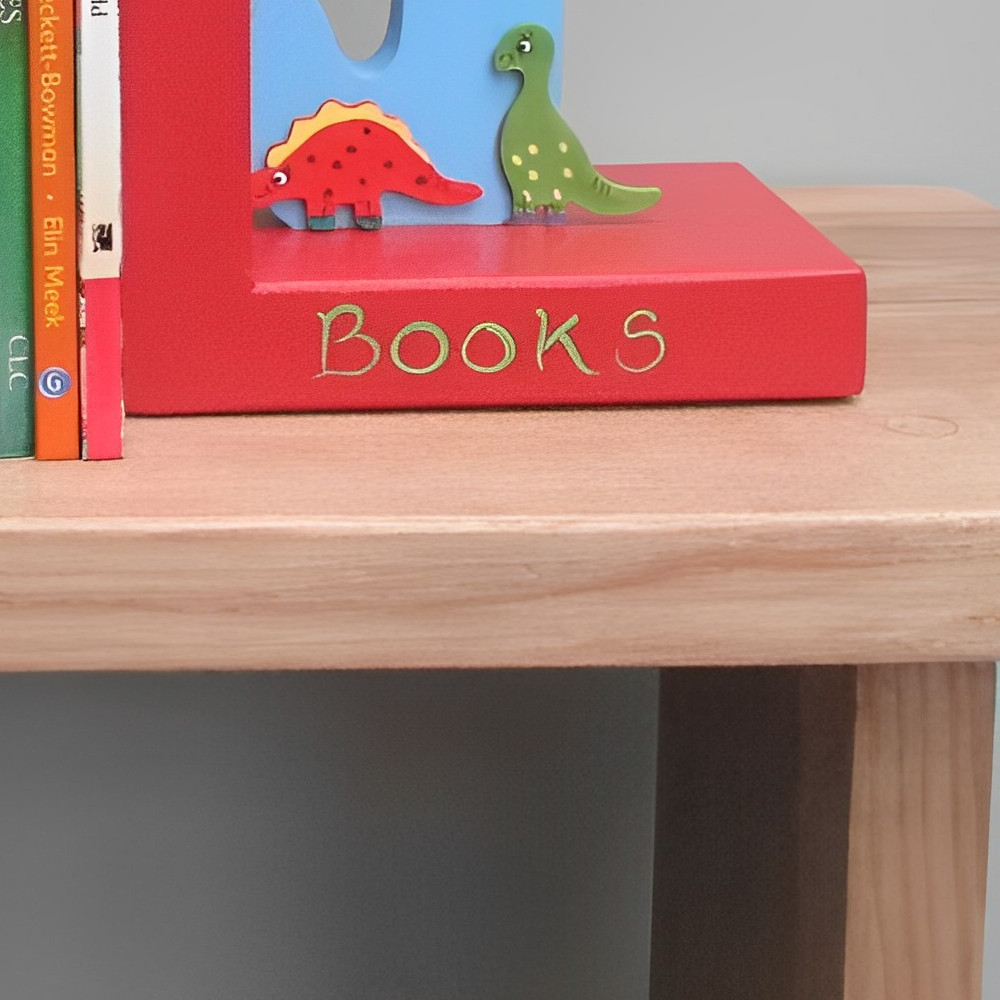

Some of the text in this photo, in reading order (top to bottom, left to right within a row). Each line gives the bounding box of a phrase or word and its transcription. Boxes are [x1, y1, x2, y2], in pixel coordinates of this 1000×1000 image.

[43, 217, 63, 256] Elin
[44, 266, 66, 328] Meek
[8, 335, 29, 390] CLC
